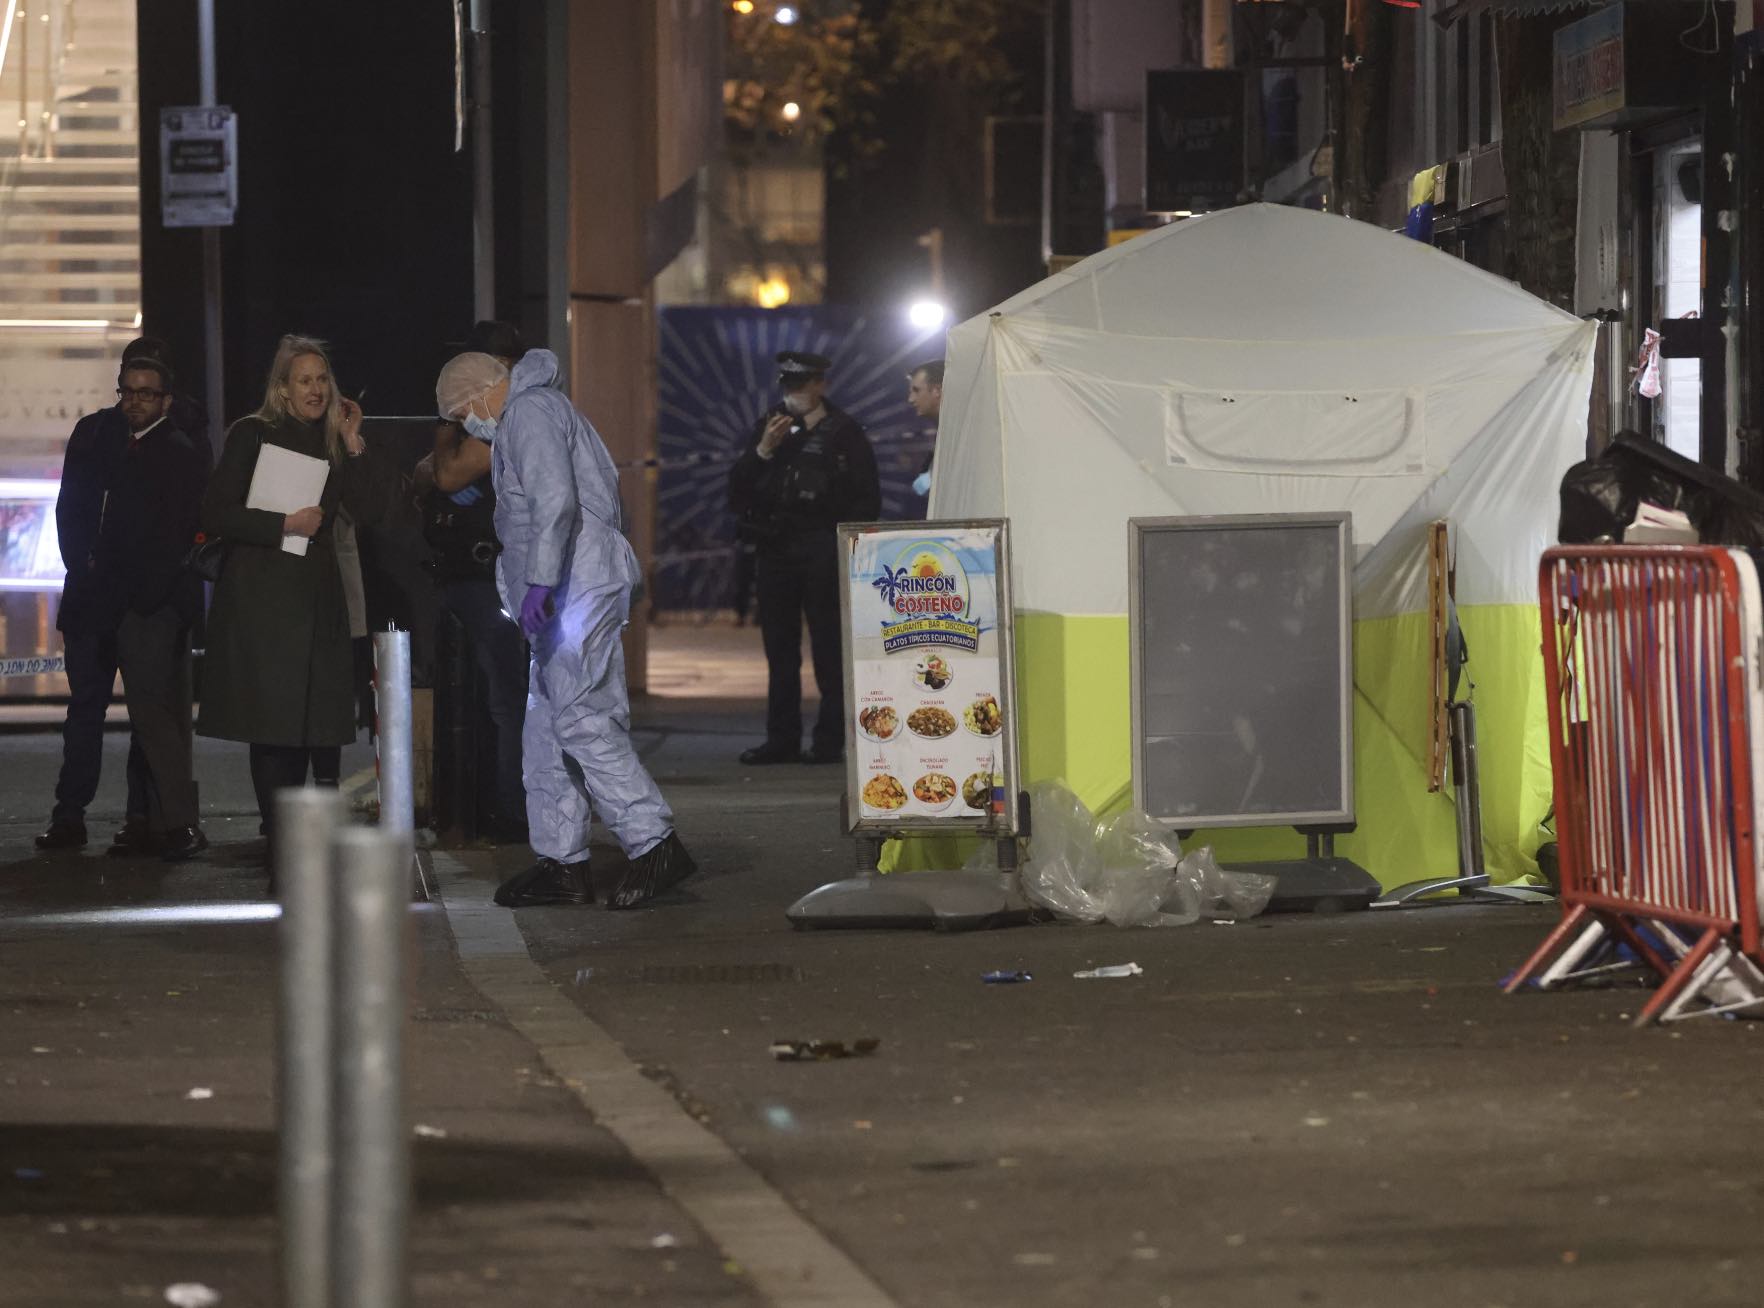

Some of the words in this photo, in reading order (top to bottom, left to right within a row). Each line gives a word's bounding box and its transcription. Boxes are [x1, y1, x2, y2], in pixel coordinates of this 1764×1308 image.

[902, 572, 955, 592] RINCÓN
[895, 592, 963, 613] COSTEÑO
[883, 622, 922, 636] RESTAURANTE
[928, 620, 941, 628] BAR
[945, 621, 976, 634] DISCOTECA
[885, 637, 907, 648] PLATOS
[908, 632, 930, 644] TÍPICOS
[931, 633, 975, 648] ECUATORIANOS
